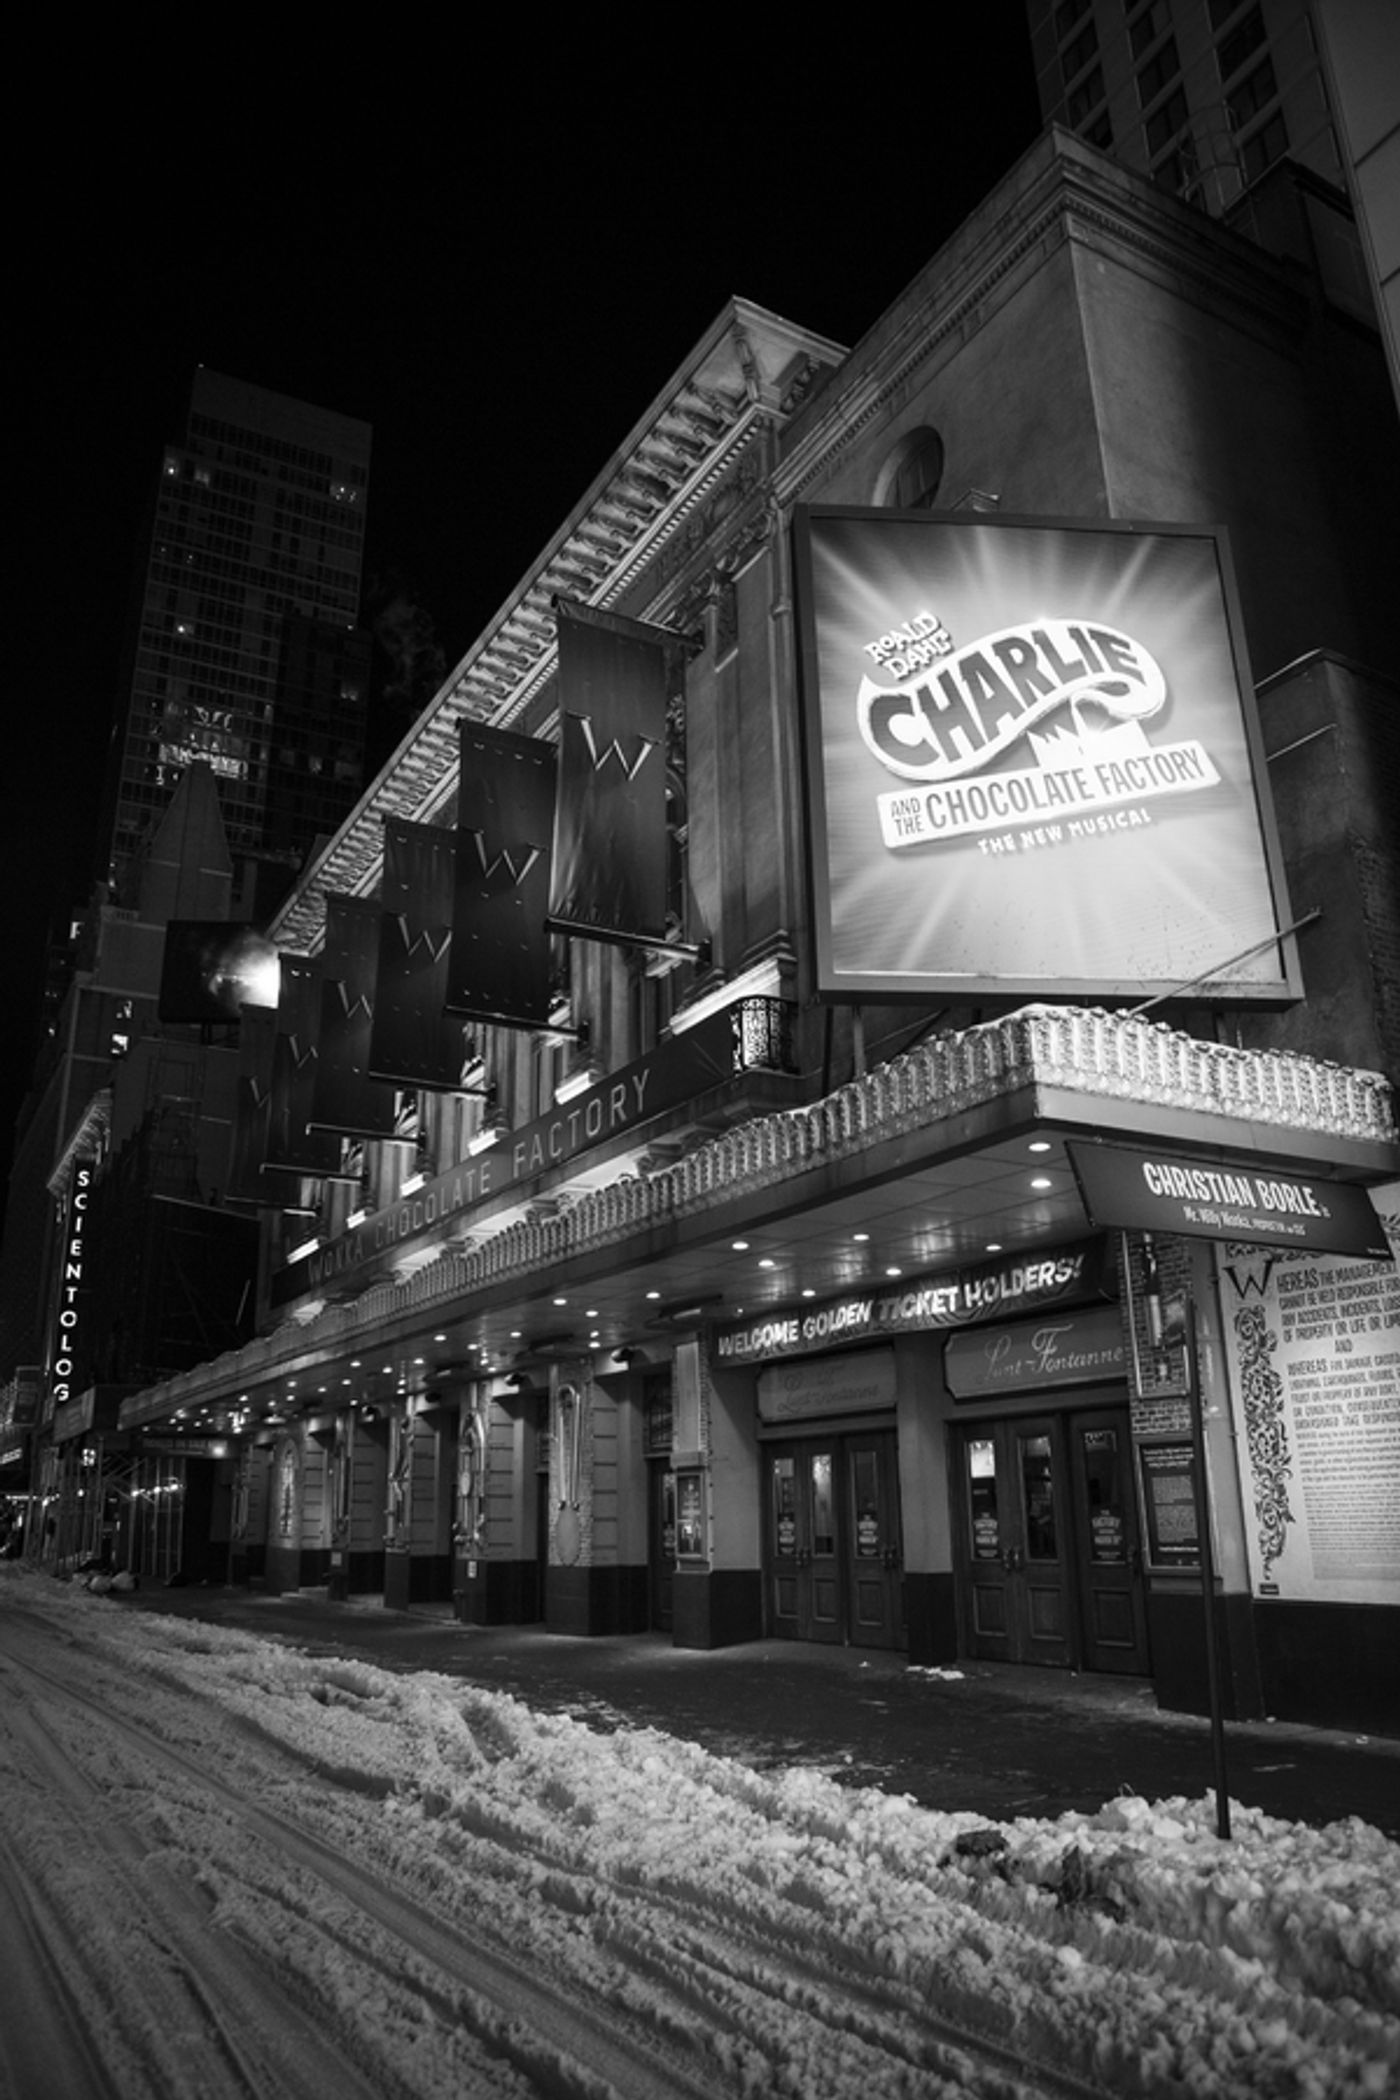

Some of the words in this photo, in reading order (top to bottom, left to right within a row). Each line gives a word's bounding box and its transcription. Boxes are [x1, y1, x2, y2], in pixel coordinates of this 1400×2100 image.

[864, 611, 939, 663] ROALD
[883, 630, 952, 680] DAHL
[869, 627, 1147, 768] CHARLIE
[564, 709, 662, 781] W
[890, 798, 921, 818] AND
[926, 768, 1095, 831] CHOCOLATE
[1093, 749, 1206, 797] FACTORY
[894, 816, 925, 837] THE
[978, 833, 1016, 856] THE
[1022, 826, 1063, 849] NEW
[1071, 808, 1152, 837] MUSICAL
[471, 828, 547, 886] W
[393, 912, 453, 963] W
[375, 1160, 491, 1250] CHOCOLATE
[512, 1068, 650, 1178] FACTORY
[1142, 1161, 1257, 1208] CHRISTIAN
[1255, 1178, 1321, 1217] BORLE
[1335, 1261, 1396, 1283] MANAGEMENT
[718, 1320, 798, 1356] WELCOME
[802, 1299, 874, 1339] GOLDEN
[879, 1286, 958, 1323] TICKET
[963, 1254, 1086, 1308] HOLDERS!
